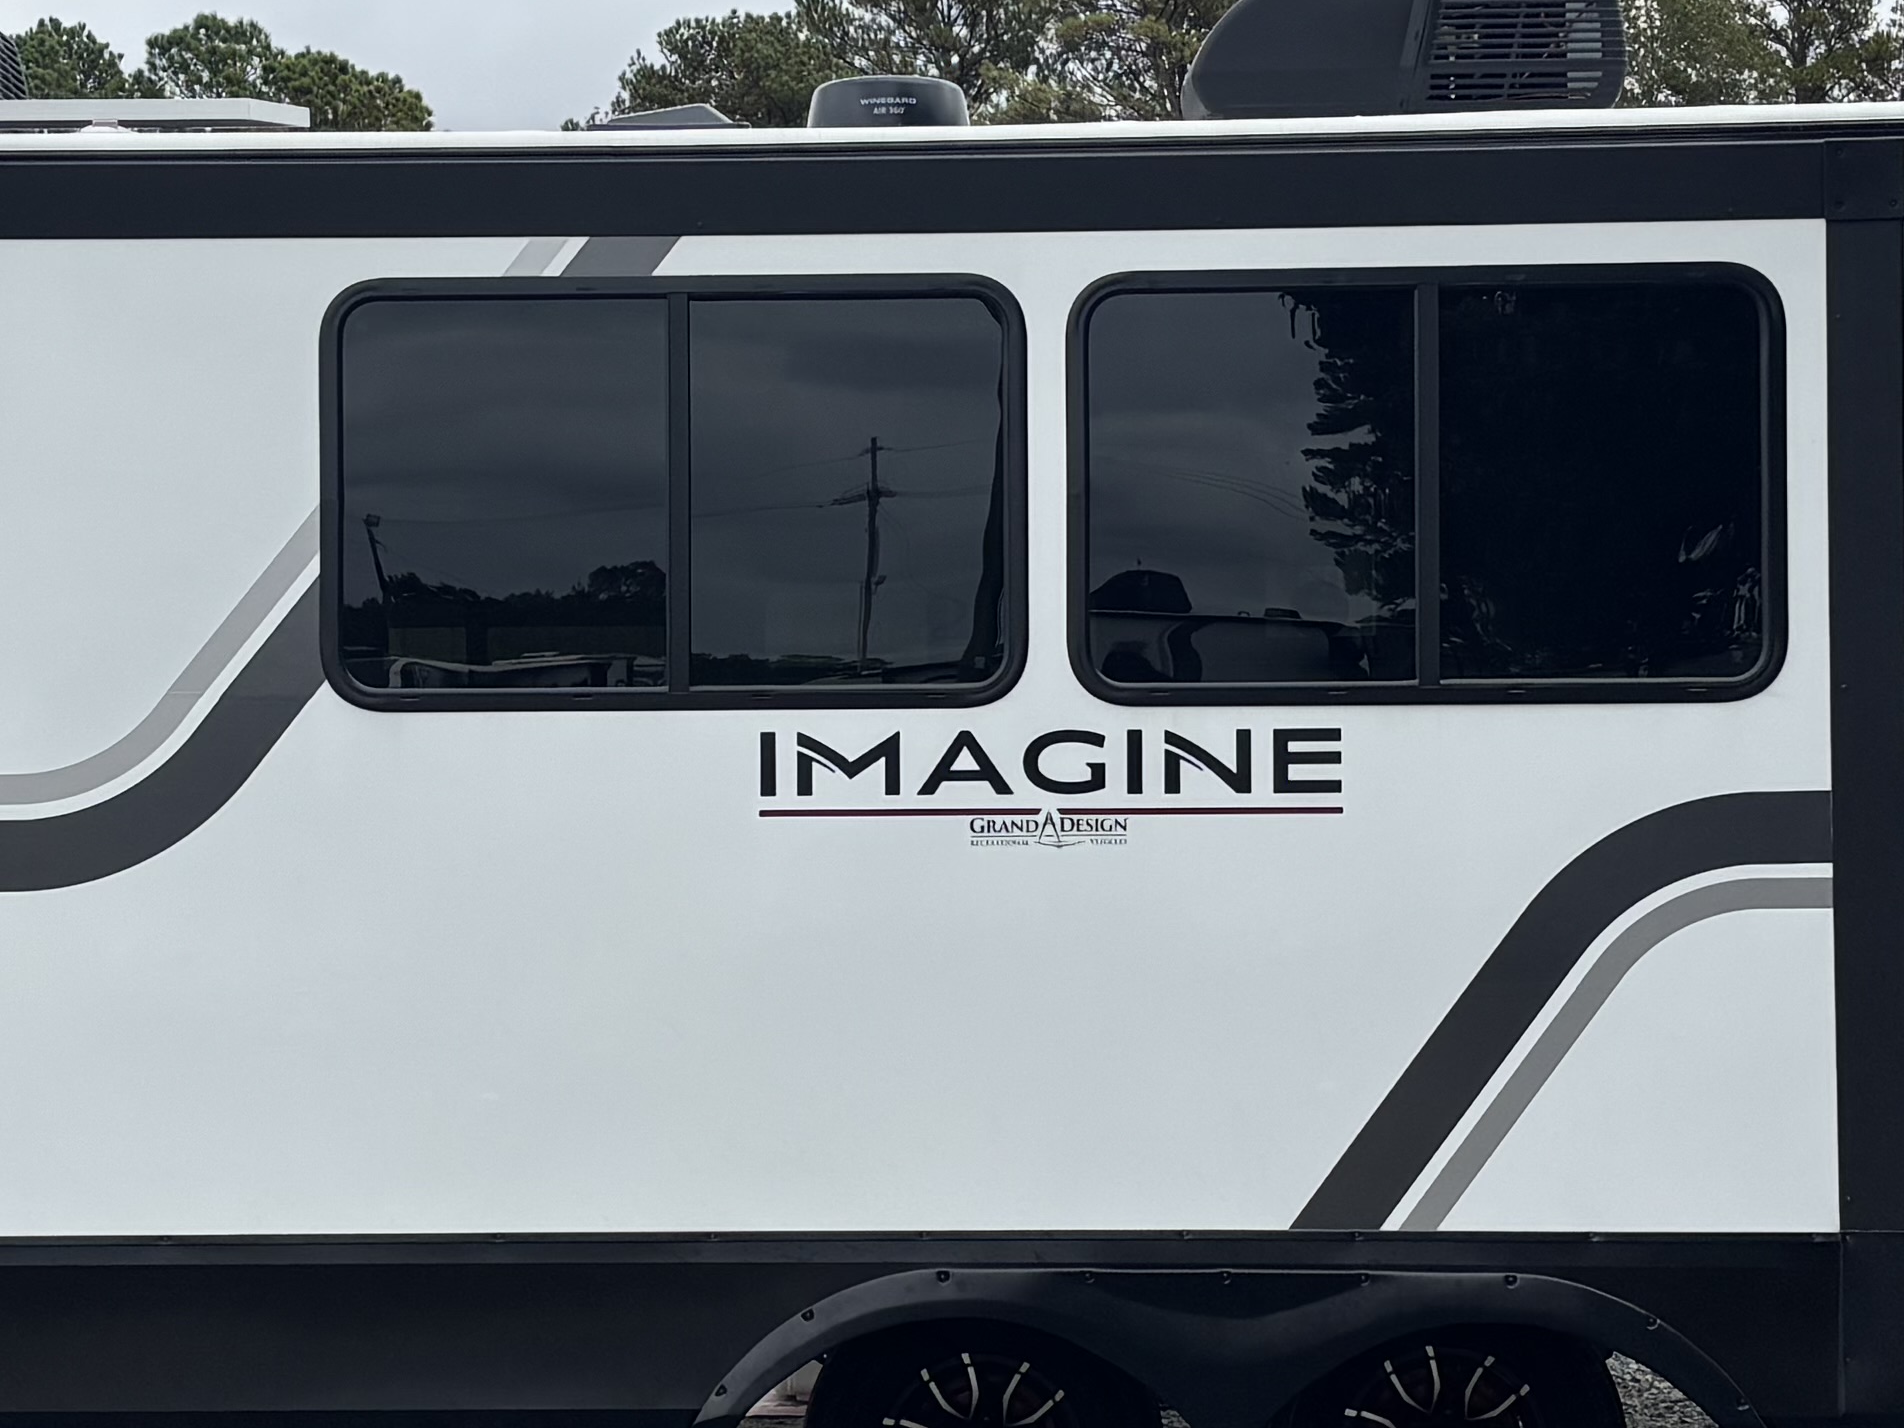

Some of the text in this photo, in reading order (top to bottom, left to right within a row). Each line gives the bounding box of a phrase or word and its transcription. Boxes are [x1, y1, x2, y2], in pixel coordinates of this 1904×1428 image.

[759, 727, 1343, 798] IMAGINE
[969, 816, 1129, 834] GRAND DESIGN
